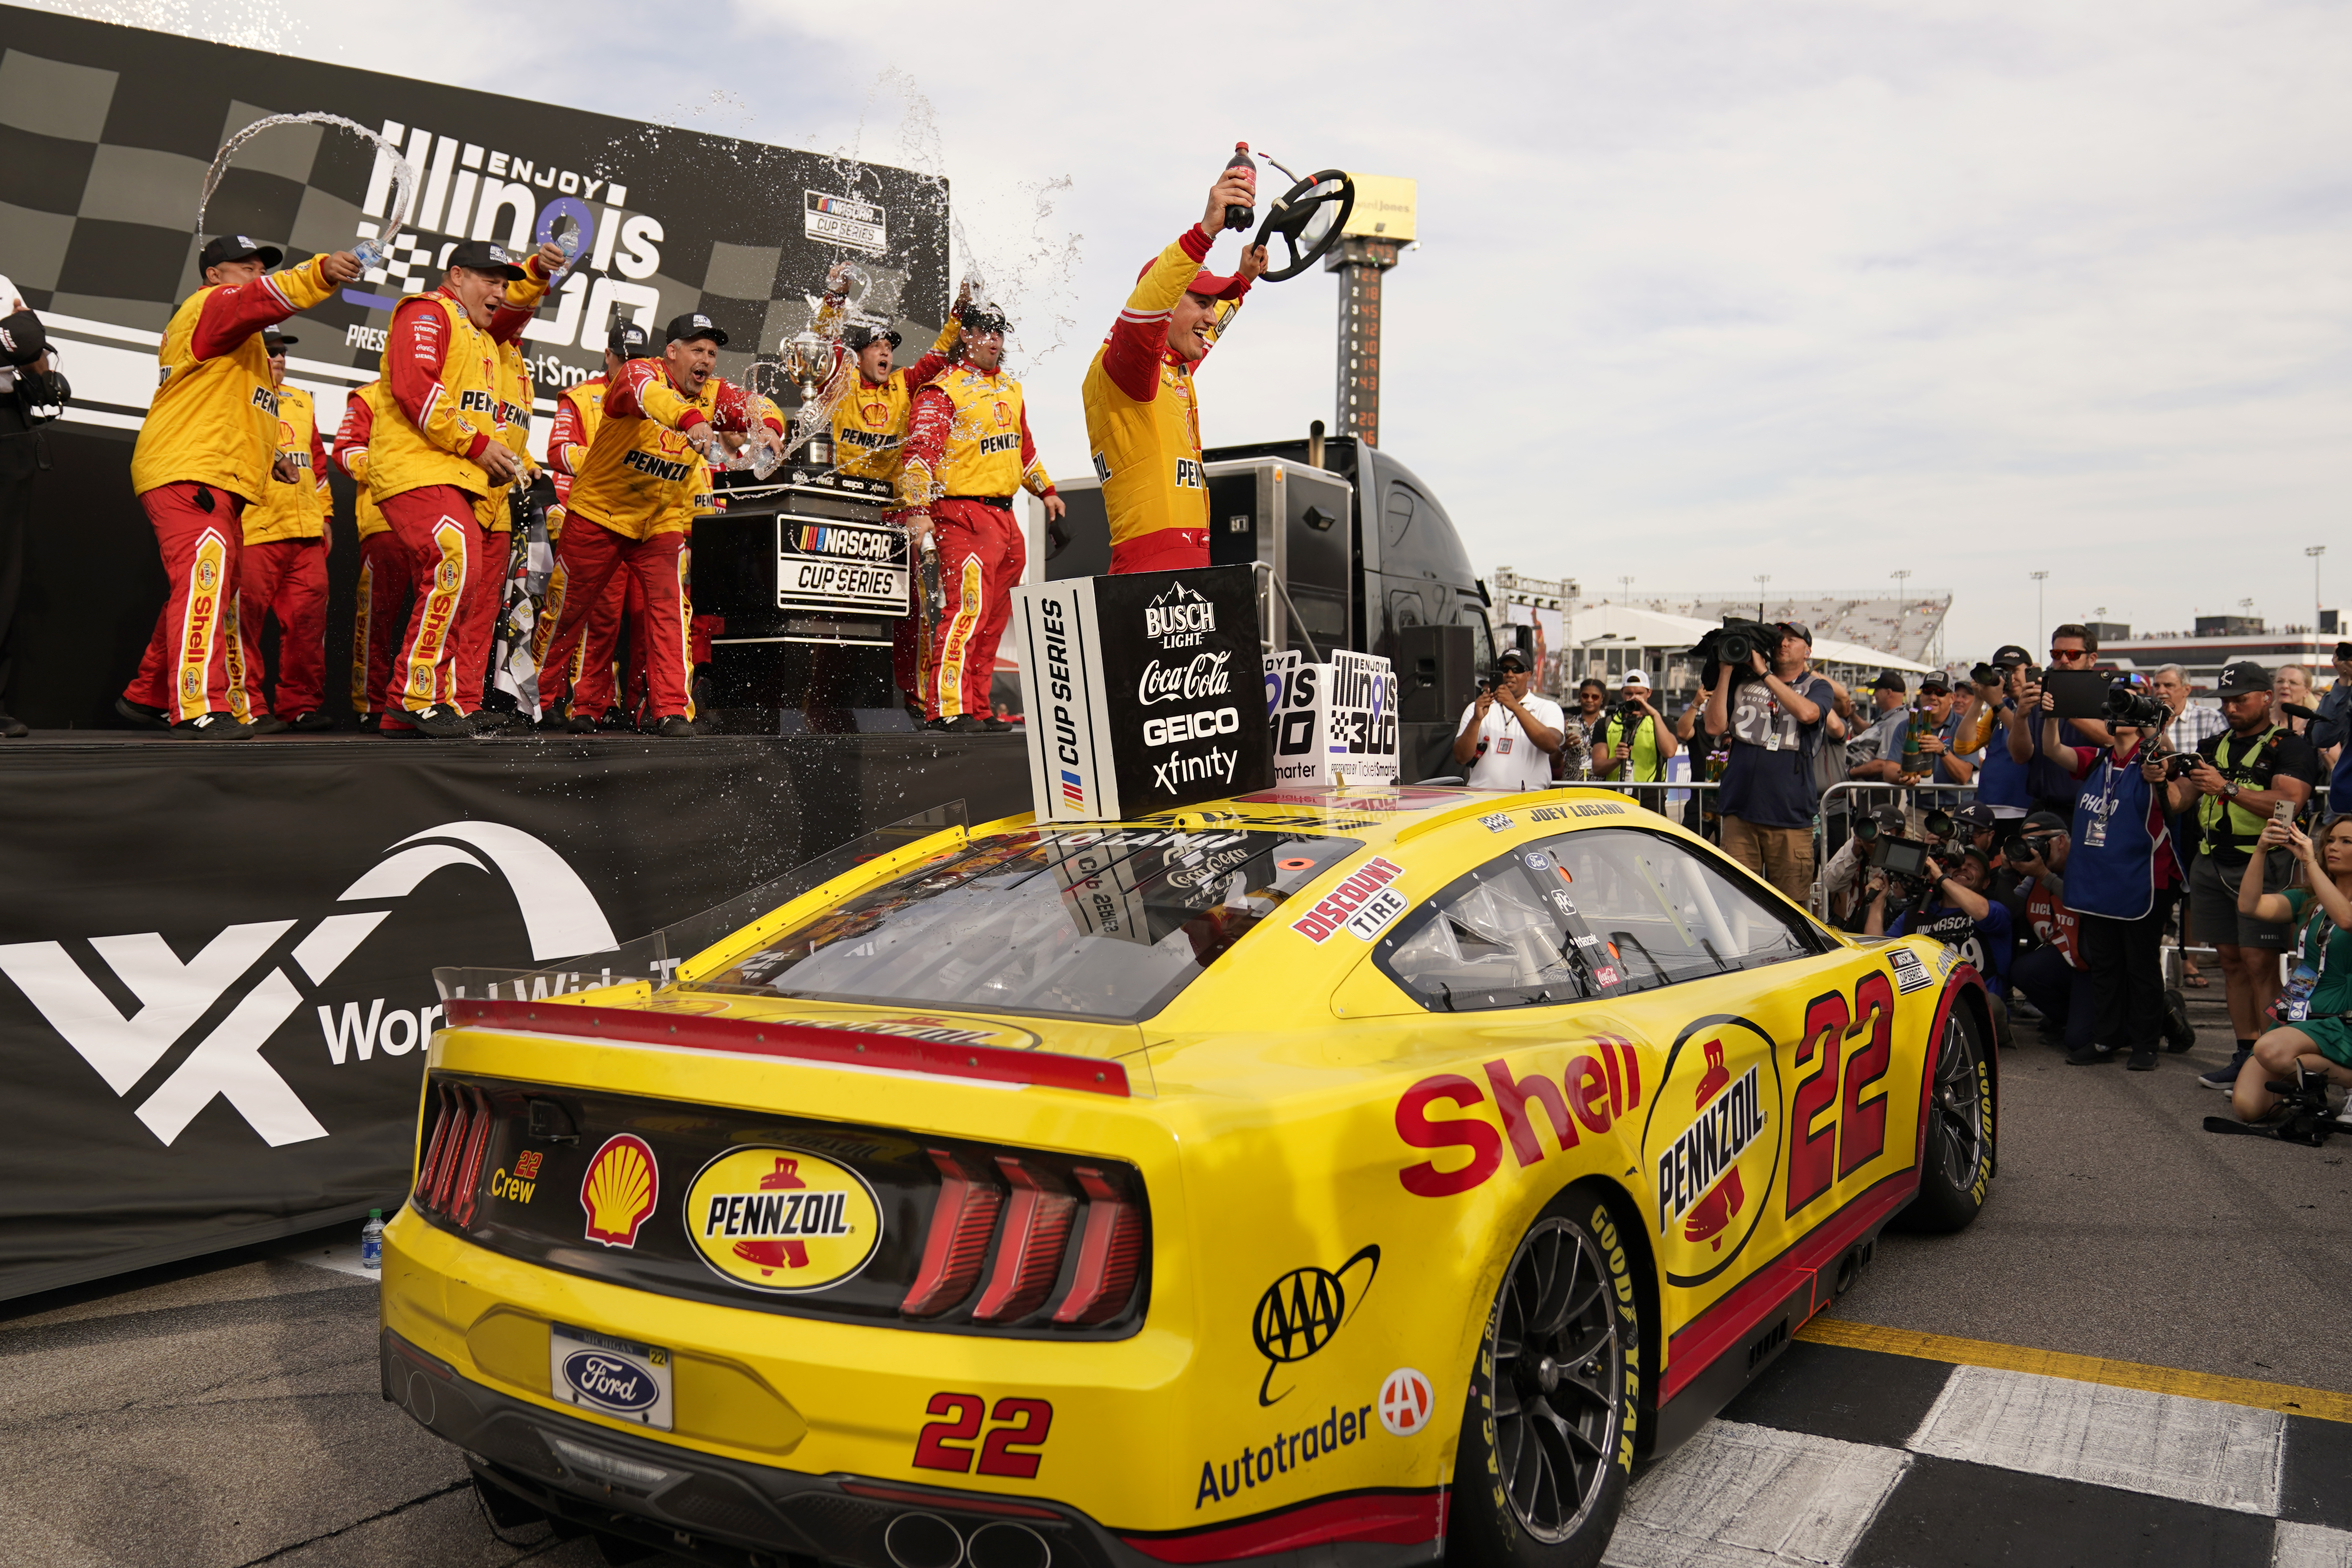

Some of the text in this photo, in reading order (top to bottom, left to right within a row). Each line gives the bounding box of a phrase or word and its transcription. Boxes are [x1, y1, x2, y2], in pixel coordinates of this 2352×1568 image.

[488, 151, 603, 199] ENJOY
[1380, 201, 1410, 213] Jones
[817, 218, 838, 231] CUP
[1354, 269, 1379, 282] 1 22
[1353, 286, 1379, 300] 2 18
[1352, 304, 1378, 318] 3 45
[1351, 322, 1377, 336] 4 12
[1351, 340, 1378, 355] 5 10
[1351, 358, 1377, 371] 6 19
[1350, 376, 1377, 390] 7 43
[1372, 395, 1377, 408] 1
[1349, 412, 1376, 426] 9 20
[1362, 430, 1376, 445] 16
[842, 480, 864, 489] GEICO
[870, 483, 890, 495] xfinity
[824, 528, 892, 558] NASCAR
[798, 566, 893, 595] CUP SERIES
[188, 596, 212, 663] Shell
[418, 596, 451, 659] Shell
[1145, 602, 1216, 639] BUSCH
[532, 615, 552, 664] Shell
[948, 615, 972, 661] Shell
[1163, 633, 1202, 649] LIGHT
[225, 634, 240, 686] Shell
[1361, 659, 1385, 673] ENJOY
[1041, 598, 1079, 766] CUP SERIES
[1139, 650, 1231, 705] Coca-Cola
[1143, 707, 1239, 746] GEICO
[1349, 712, 1395, 755] 300
[1735, 705, 1797, 746] 211
[1153, 746, 1238, 795] xfinity
[1352, 764, 1357, 774] BY
[1358, 761, 1397, 777] TicketSmarter
[1530, 803, 1624, 822] JOEY LOGANO
[1529, 855, 1546, 867] Ford
[1293, 857, 1403, 942] DISCOUNT
[1353, 893, 1401, 933] TIRE
[1555, 892, 1574, 911] PPG
[1574, 933, 1599, 948] Mazak
[1897, 952, 1914, 966] NASCAR
[1597, 967, 1618, 986] Coca-Cola
[1907, 967, 1923, 982] SERIES
[1786, 969, 1895, 1220] 22
[1394, 1031, 1640, 1198] Shell
[1659, 1066, 1764, 1234] PENNZOIL
[514, 1151, 543, 1179] 22
[492, 1168, 536, 1204] Crew
[706, 1193, 847, 1235] PENNZOIL
[1265, 1272, 1336, 1359] AAA
[583, 1333, 633, 1355] MICHIGAN
[651, 1350, 664, 1365] 22
[581, 1356, 637, 1401] Ford
[913, 1393, 1052, 1478] 22
[1195, 1405, 1372, 1510] Autotrader
